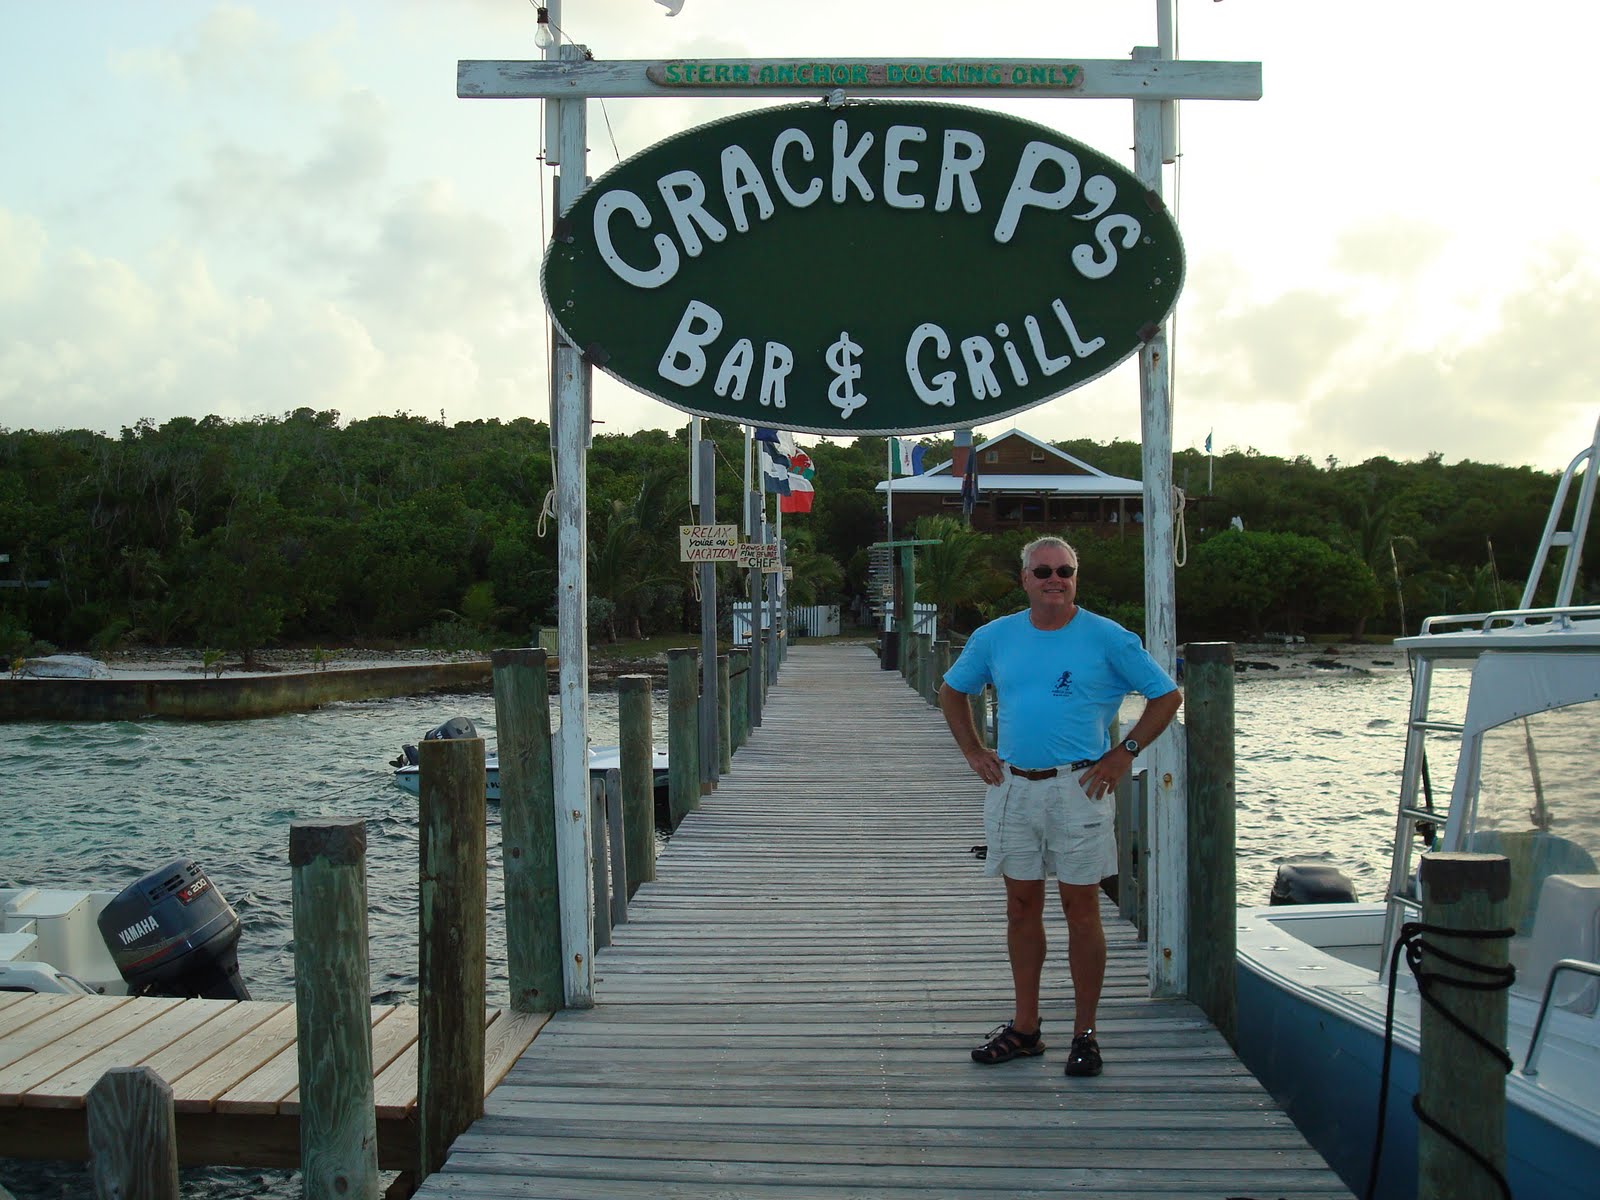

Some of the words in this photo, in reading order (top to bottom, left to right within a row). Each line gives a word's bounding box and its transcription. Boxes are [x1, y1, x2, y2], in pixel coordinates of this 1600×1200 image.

[665, 64, 751, 83] STERN
[758, 64, 868, 84] ANCHOR
[887, 64, 1001, 84] DOCKING
[1011, 66, 1080, 85] ONLY
[592, 119, 987, 290] CRACKER
[657, 299, 795, 410] BAR
[826, 331, 868, 420] &
[691, 527, 731, 538] RELAX
[686, 547, 737, 560] VACATION
[190, 878, 208, 893] 200
[118, 915, 159, 945] YAMAHA
